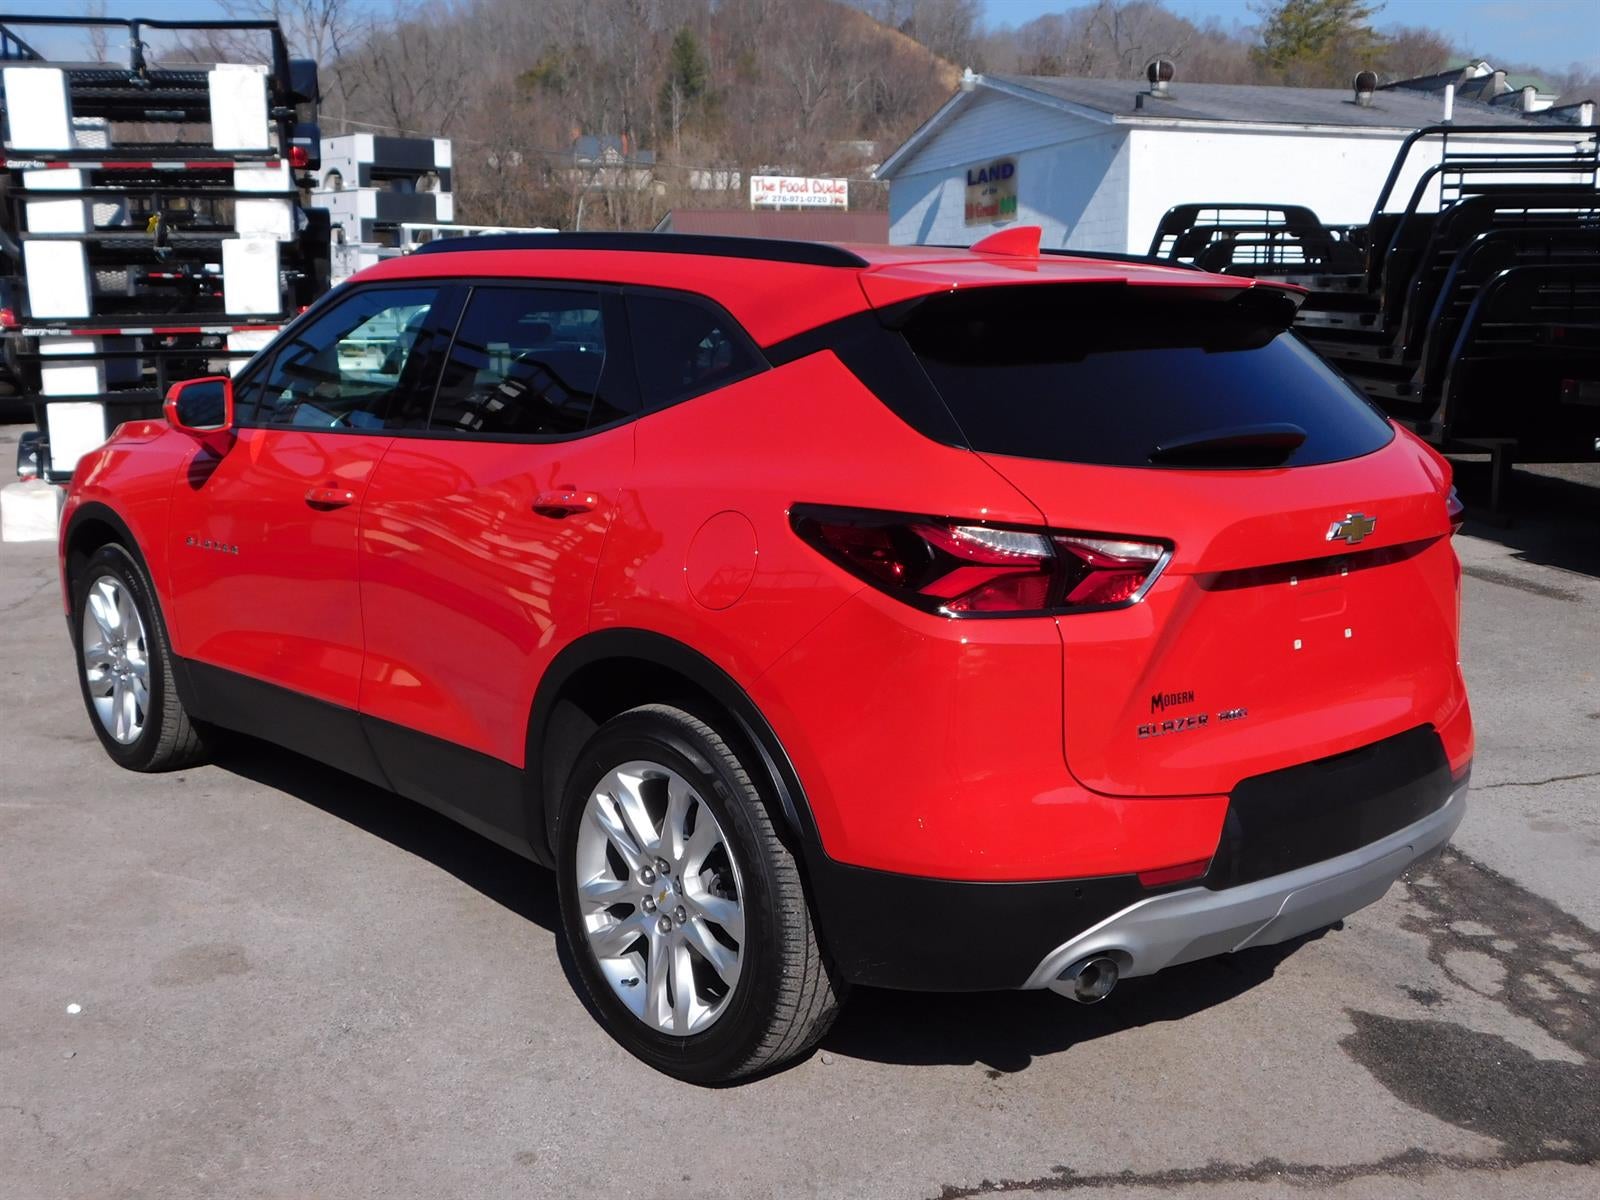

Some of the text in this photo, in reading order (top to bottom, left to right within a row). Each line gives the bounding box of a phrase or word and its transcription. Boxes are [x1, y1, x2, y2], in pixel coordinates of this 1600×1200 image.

[967, 163, 1015, 186] LAND
[753, 178, 846, 195] The Food Dude
[1137, 714, 1209, 739] BLAZER
